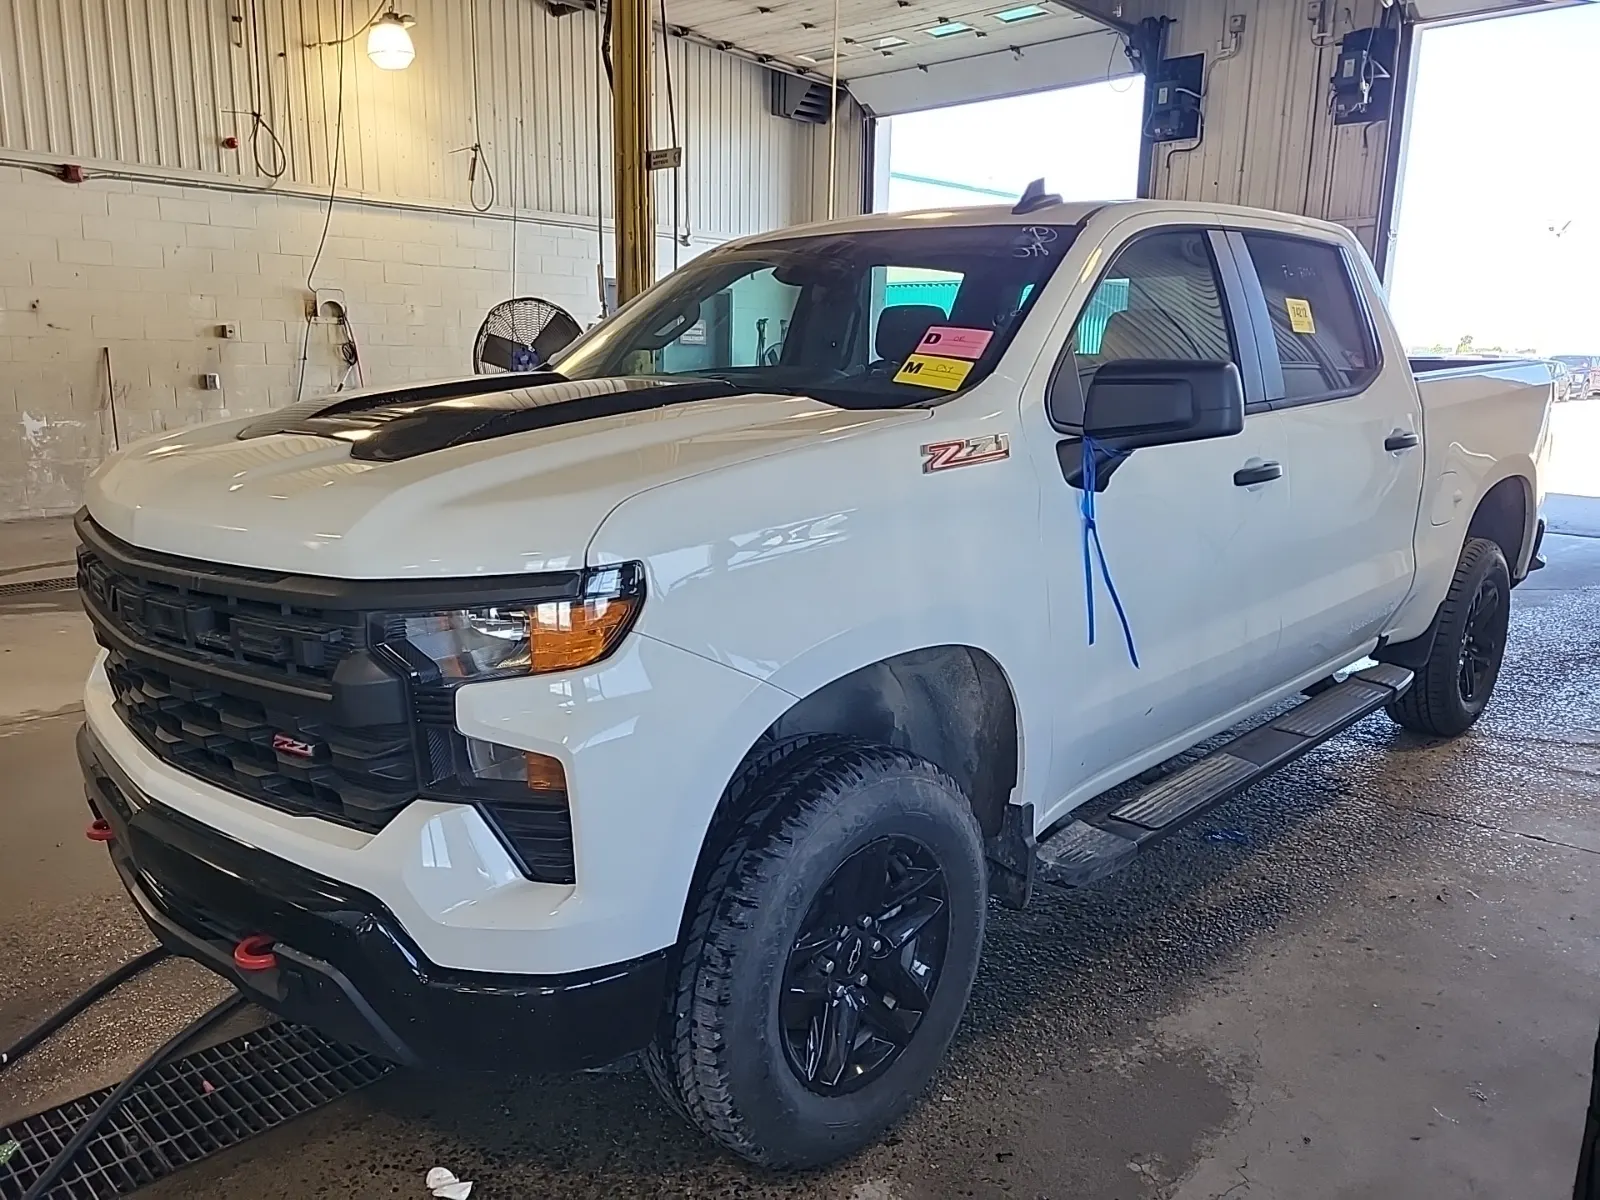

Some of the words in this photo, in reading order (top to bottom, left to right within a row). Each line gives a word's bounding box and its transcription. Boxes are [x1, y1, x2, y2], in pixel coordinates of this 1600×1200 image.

[923, 333, 942, 344] D
[902, 361, 924, 374] M
[920, 432, 1010, 475] Z71
